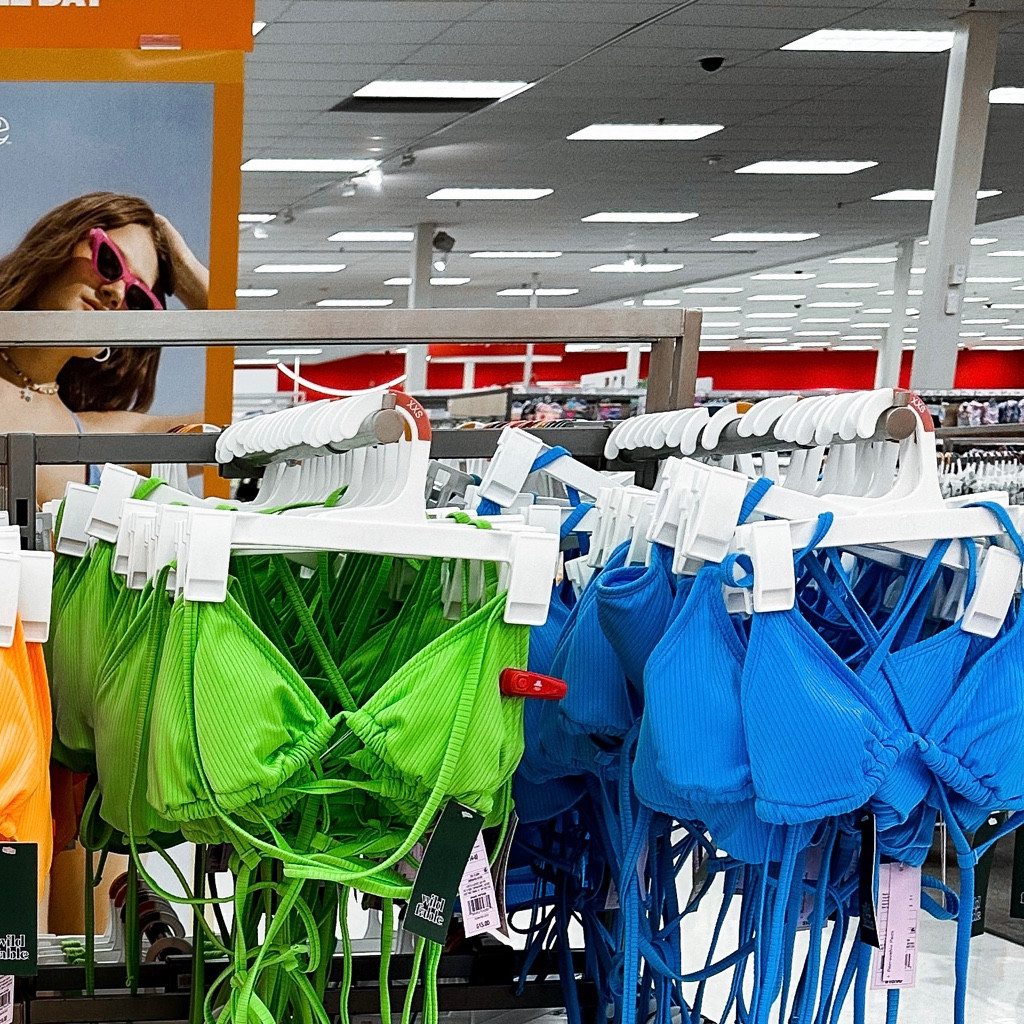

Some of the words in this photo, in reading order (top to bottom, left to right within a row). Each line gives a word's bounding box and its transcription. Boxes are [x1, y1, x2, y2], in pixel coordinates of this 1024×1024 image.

[406, 400, 424, 418] XXS
[911, 397, 925, 414] XXS
[421, 893, 446, 914] wild
[414, 902, 445, 926] fable
